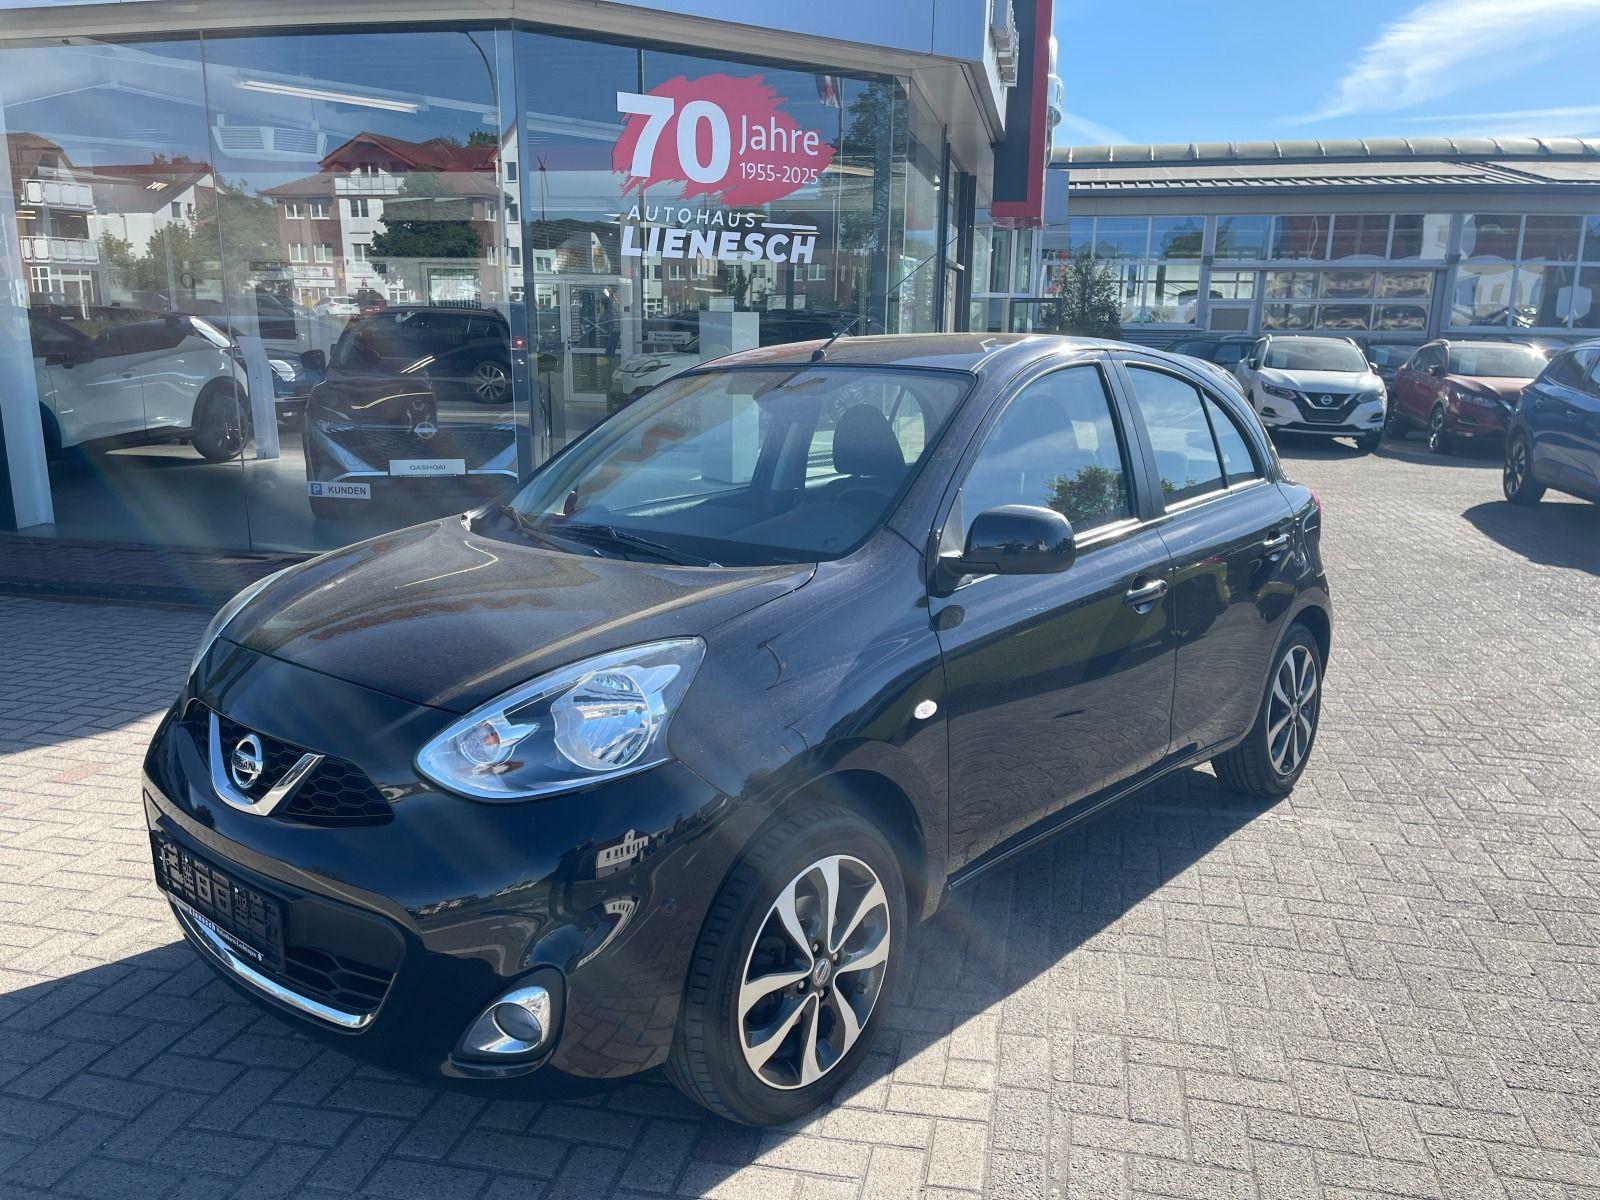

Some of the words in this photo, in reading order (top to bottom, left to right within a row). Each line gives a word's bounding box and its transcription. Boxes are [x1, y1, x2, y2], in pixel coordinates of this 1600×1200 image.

[616, 91, 731, 184] 70
[738, 114, 819, 156] Jahre
[739, 162, 819, 185] 1955-2025
[627, 204, 756, 228] AUTOHAUS
[620, 225, 816, 264] LIENESCH
[313, 486, 320, 494] P
[328, 485, 367, 496] KUNDEN
